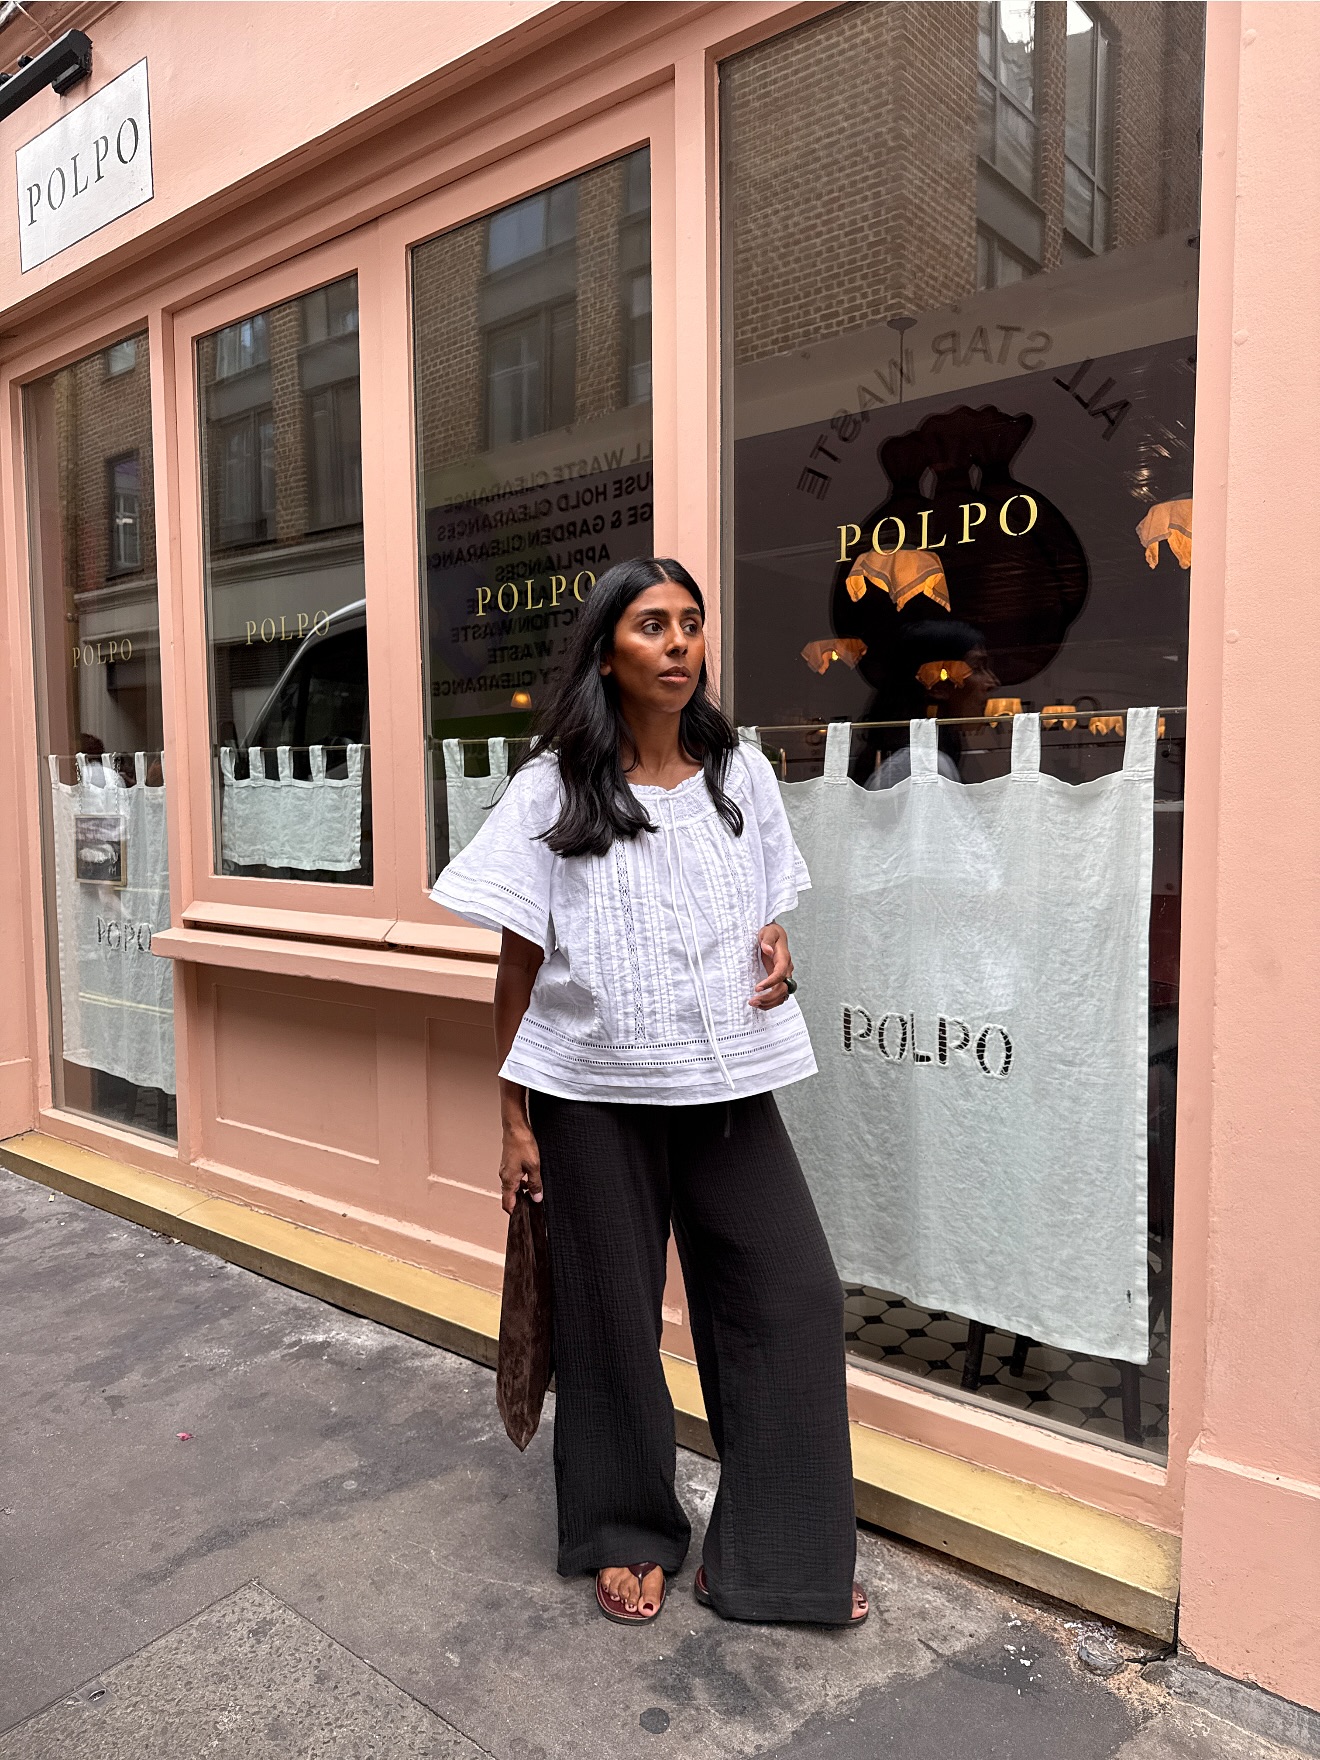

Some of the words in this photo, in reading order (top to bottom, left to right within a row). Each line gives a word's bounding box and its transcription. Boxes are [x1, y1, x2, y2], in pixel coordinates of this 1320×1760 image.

[27, 117, 139, 226] POLPO
[834, 493, 1039, 563] POLPO
[475, 570, 597, 617] POLPO
[72, 638, 133, 668] POLPO
[245, 609, 331, 646] POLPO
[841, 1002, 1014, 1079] POLPO
